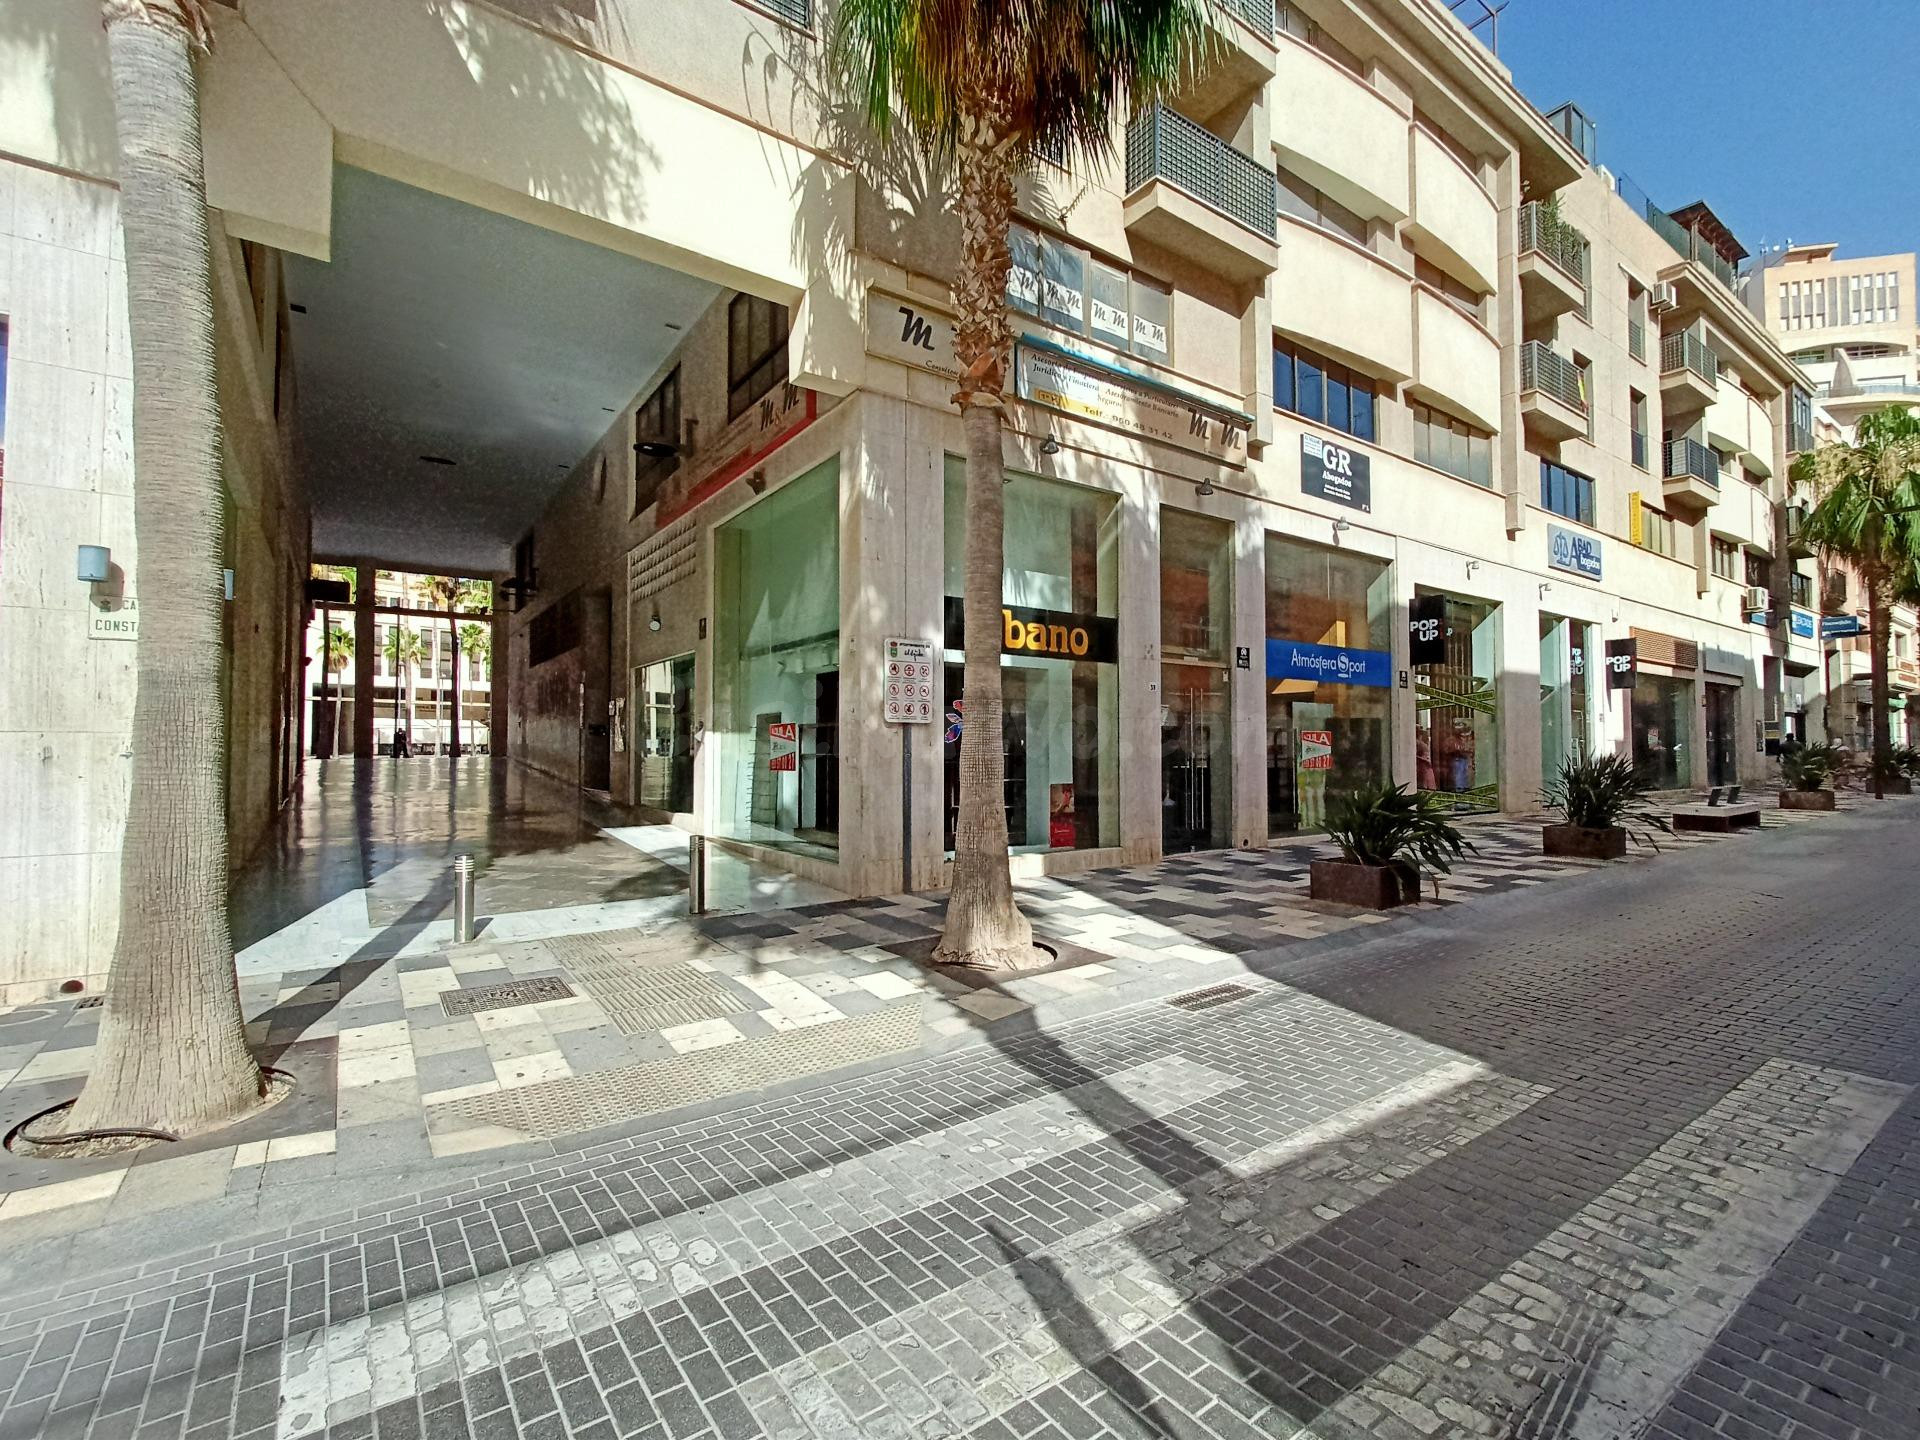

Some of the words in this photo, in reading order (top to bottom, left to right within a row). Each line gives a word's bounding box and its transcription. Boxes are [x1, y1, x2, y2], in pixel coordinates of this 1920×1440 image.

[1323, 444, 1352, 477] GR
[1322, 470, 1352, 487] Abogados
[95, 619, 138, 632] CONST
[1410, 618, 1438, 632] POP
[1002, 609, 1089, 656] bano
[1419, 629, 1439, 642] UP
[1291, 648, 1337, 676] Atmósfera
[1337, 652, 1366, 679] Sport
[1606, 655, 1631, 666] POP
[1613, 664, 1632, 673] UP
